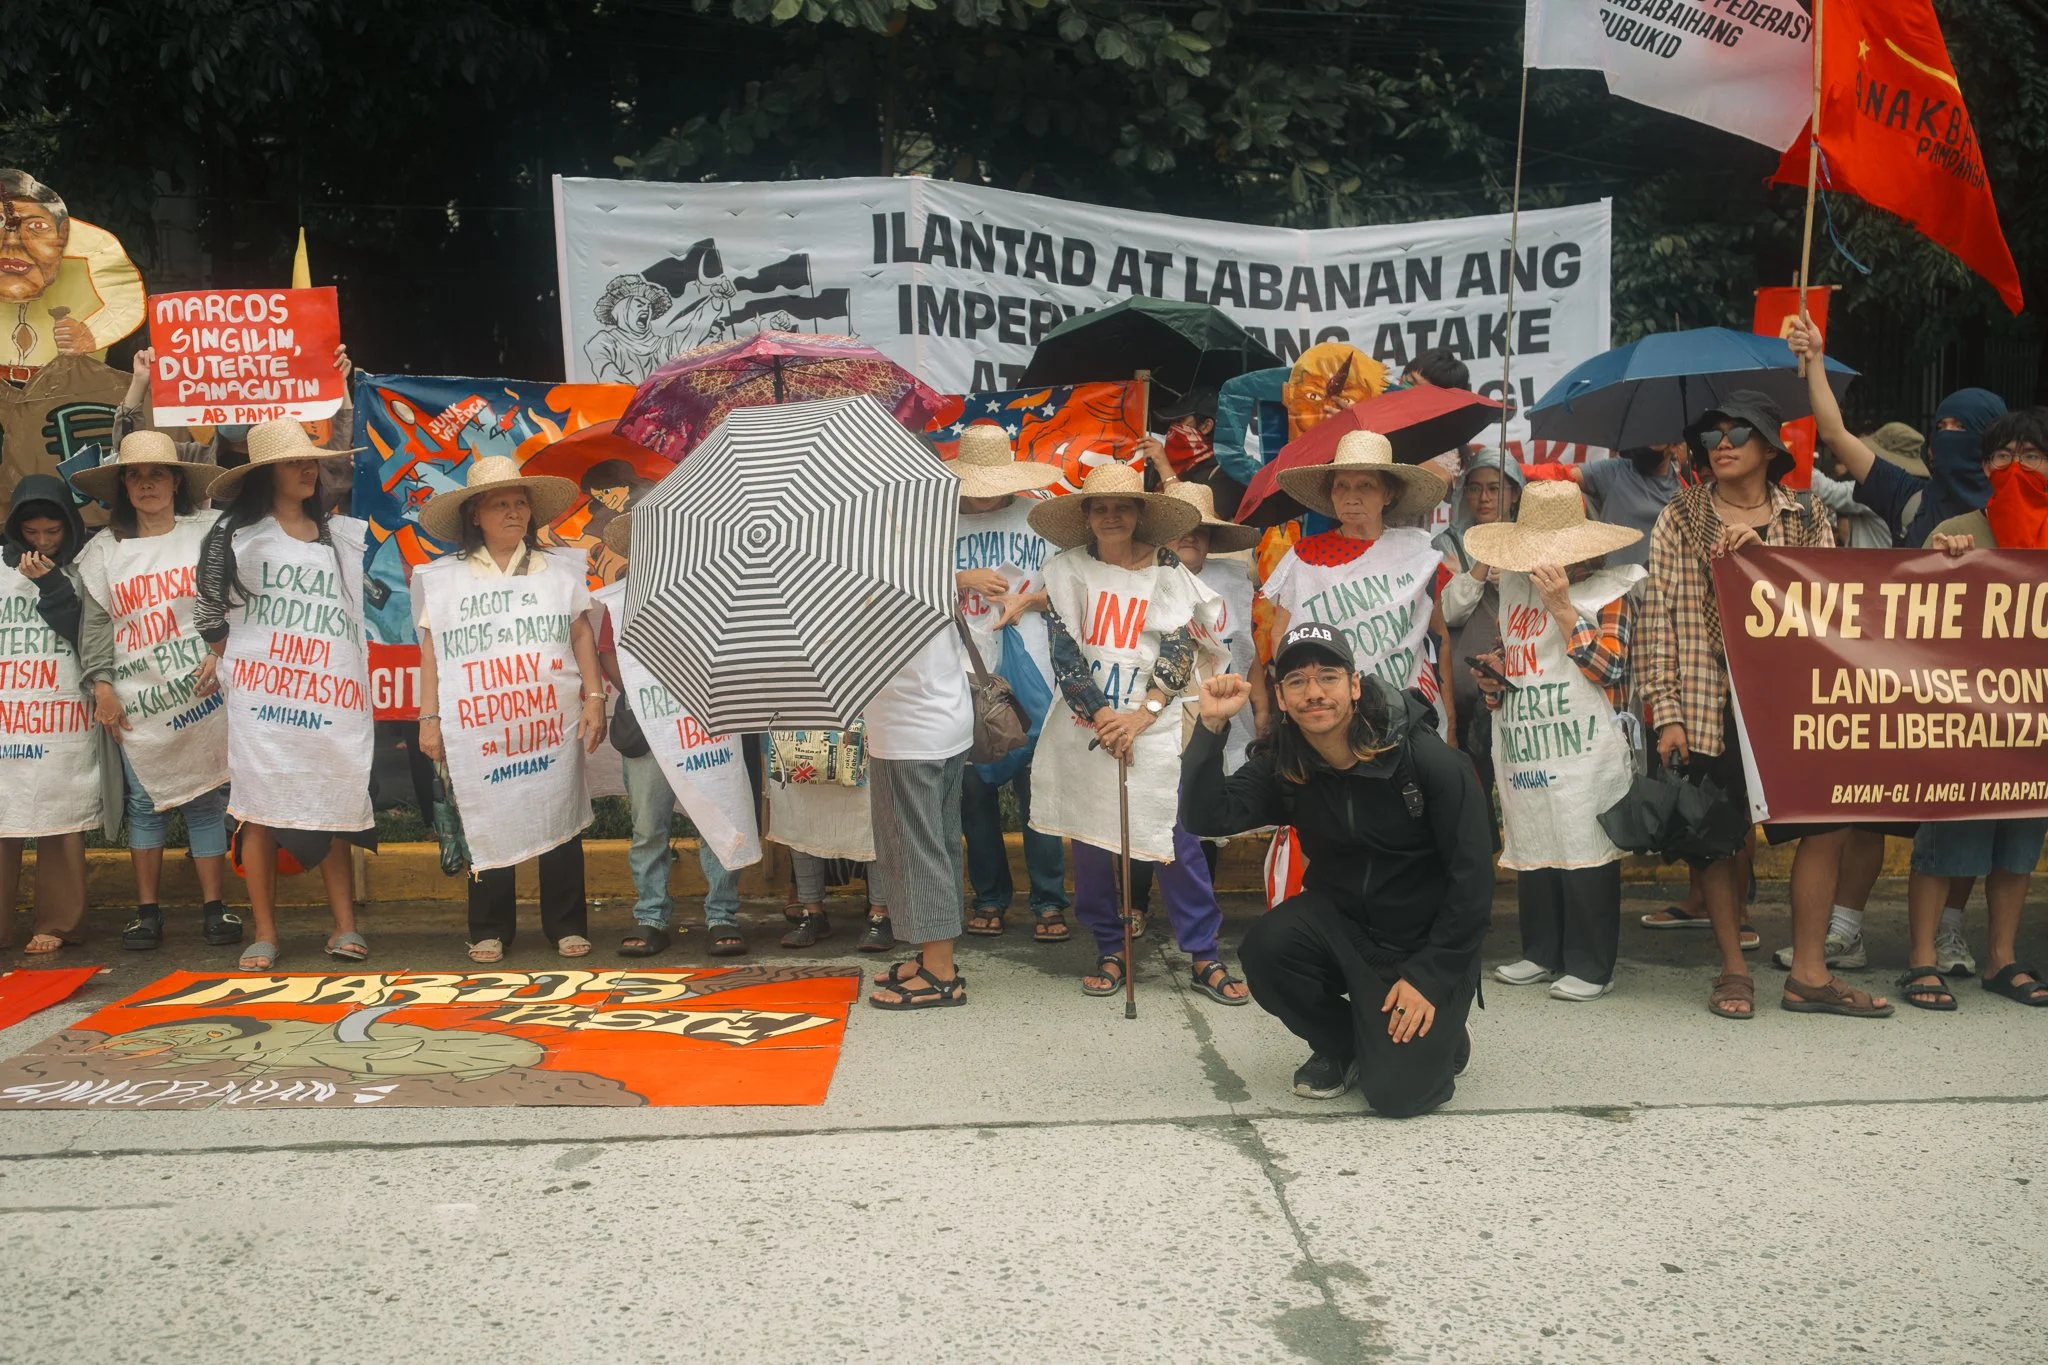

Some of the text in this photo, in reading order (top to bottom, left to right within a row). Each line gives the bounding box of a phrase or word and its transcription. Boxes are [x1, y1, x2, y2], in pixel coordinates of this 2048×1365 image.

[1606, 0, 1744, 47] BABAIHANG
[1916, 136, 1986, 191] PAMPANGA
[872, 211, 1582, 312] ILANTAD AT LABANAN ANG
[156, 293, 289, 325] MARCOS
[898, 283, 1096, 347] IMPER
[1372, 308, 1552, 367] ATAKE
[171, 328, 302, 356] SINGILIN,
[158, 354, 290, 381] DUTERTE
[178, 378, 320, 403] PANAGUTIN
[428, 402, 462, 434] JUNK
[262, 561, 338, 600] LOKAL
[0, 595, 39, 625] ARA
[460, 590, 514, 622] SAGOT
[1302, 574, 1394, 625] TUNAY
[1745, 580, 1864, 638] SAVE
[1880, 583, 1967, 639] THE
[269, 632, 331, 668] HINDI
[442, 622, 493, 660] KRISIS
[462, 652, 541, 693] TUNAY
[1812, 668, 2048, 704] LAND-USE CON
[458, 683, 558, 730] REPORMA
[639, 685, 681, 720] PRE
[505, 713, 565, 758] LUPA!
[1793, 714, 1871, 750] RICE
[1831, 783, 1910, 804] BAYAN-GL
[1924, 782, 1966, 803] AMGL
